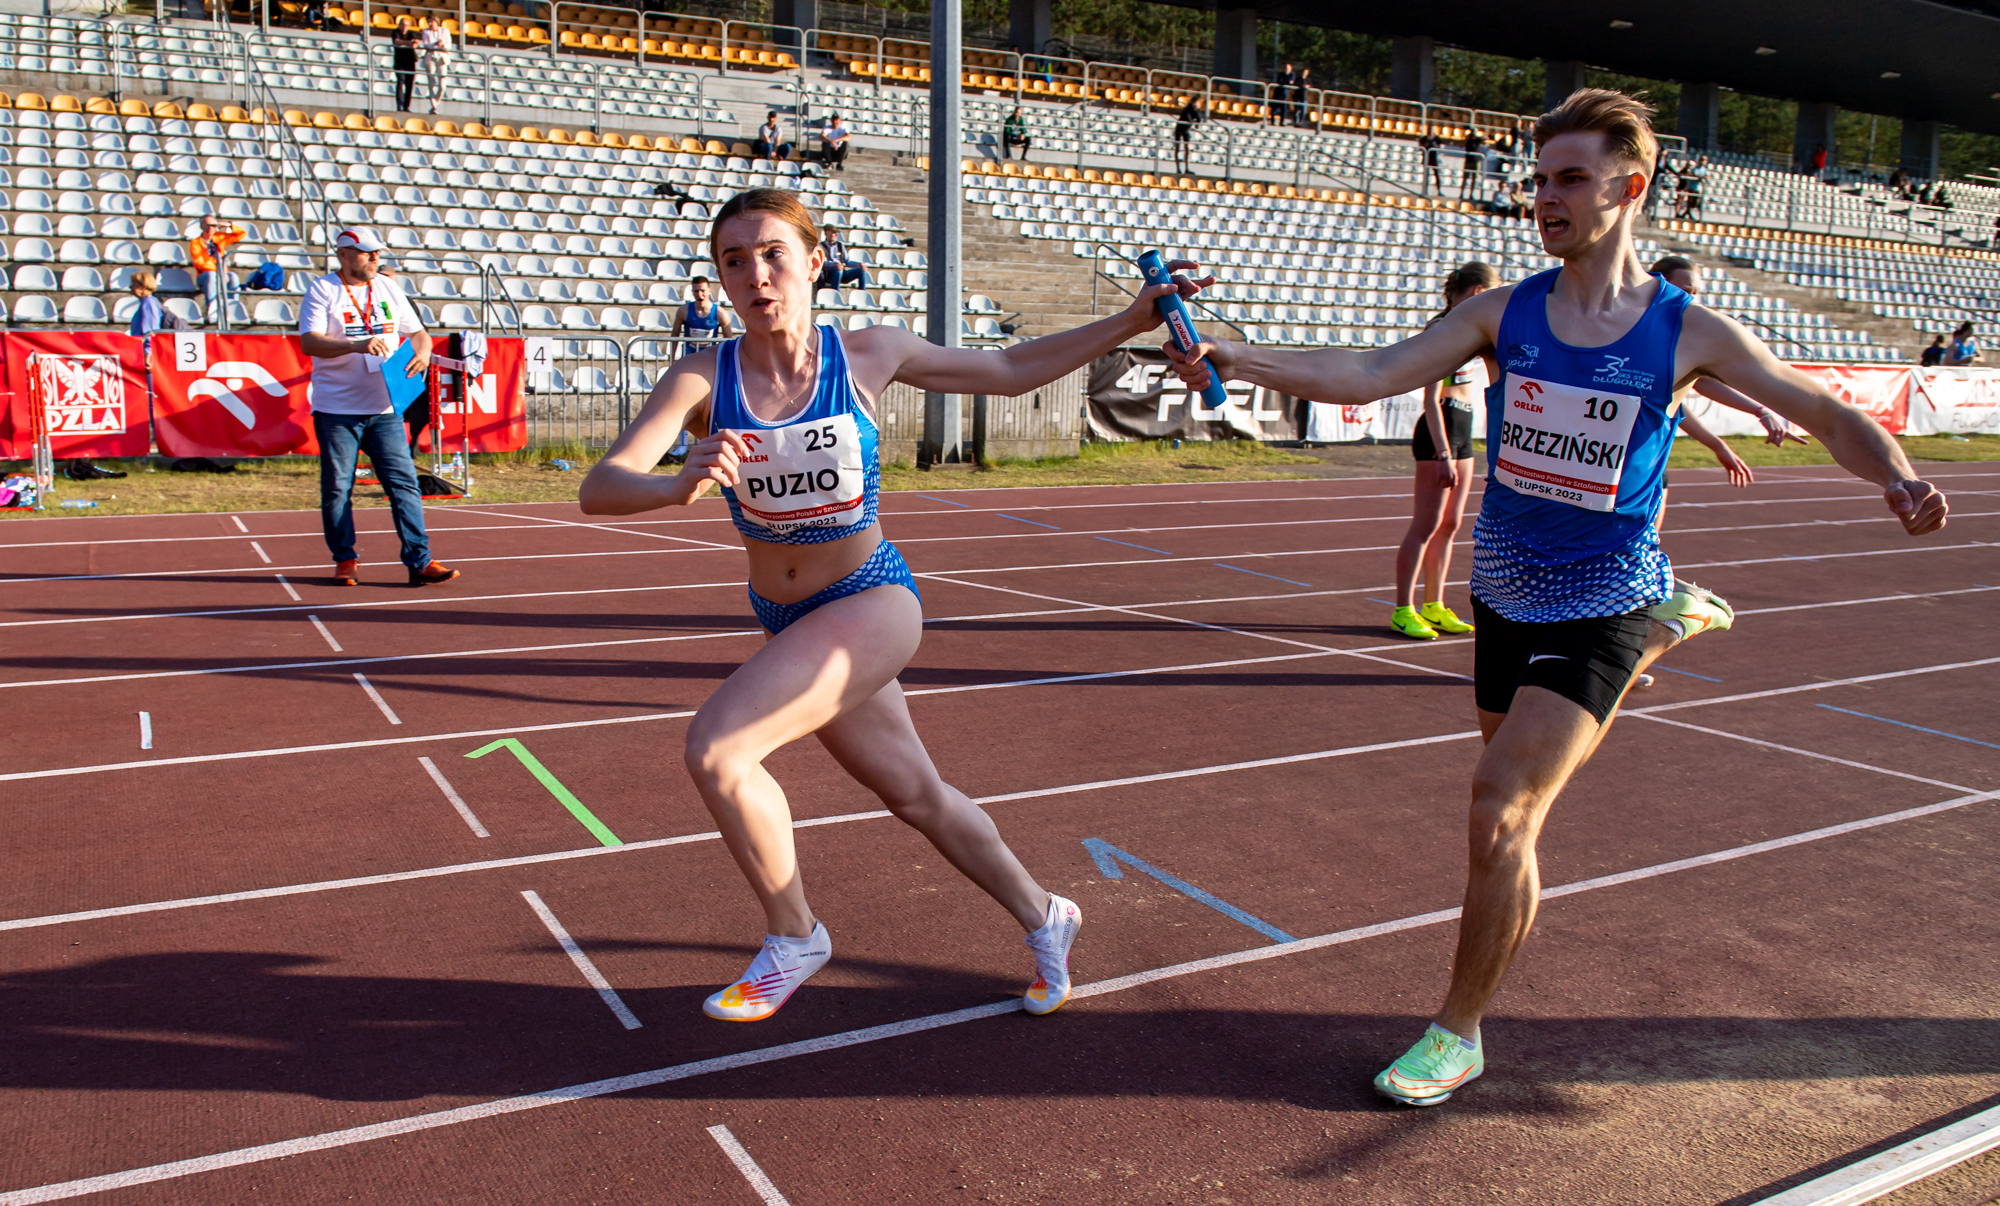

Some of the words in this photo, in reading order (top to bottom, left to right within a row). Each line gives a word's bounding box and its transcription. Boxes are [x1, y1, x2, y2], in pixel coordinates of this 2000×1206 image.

[1174, 323, 1192, 348] polanik
[184, 342, 198, 363] 3
[533, 346, 547, 365] 4
[1115, 364, 1168, 394] 4F
[1633, 375, 1655, 384] START
[1157, 378, 1283, 422] FUEL
[1380, 400, 1418, 413] Sportu
[1514, 399, 1544, 414] ORLEN
[1583, 397, 1619, 422] 10
[46, 408, 121, 431] PZLA
[803, 424, 838, 452] 25
[1501, 420, 1625, 470] BRZEZIŃSKI
[747, 468, 840, 499] PUZIO
[1501, 462, 1511, 470] PZLA
[1511, 465, 1545, 480] Mistrzostwa
[1546, 475, 1566, 484] Polski
[1573, 480, 1610, 493] Sztafetach
[1514, 478, 1553, 495] SŁUPSK
[1555, 488, 1584, 502] 2023
[796, 510, 816, 518] Polski
[823, 501, 858, 513] Sztafetach
[766, 522, 807, 531] SŁUPSK
[809, 516, 838, 527] 2023
